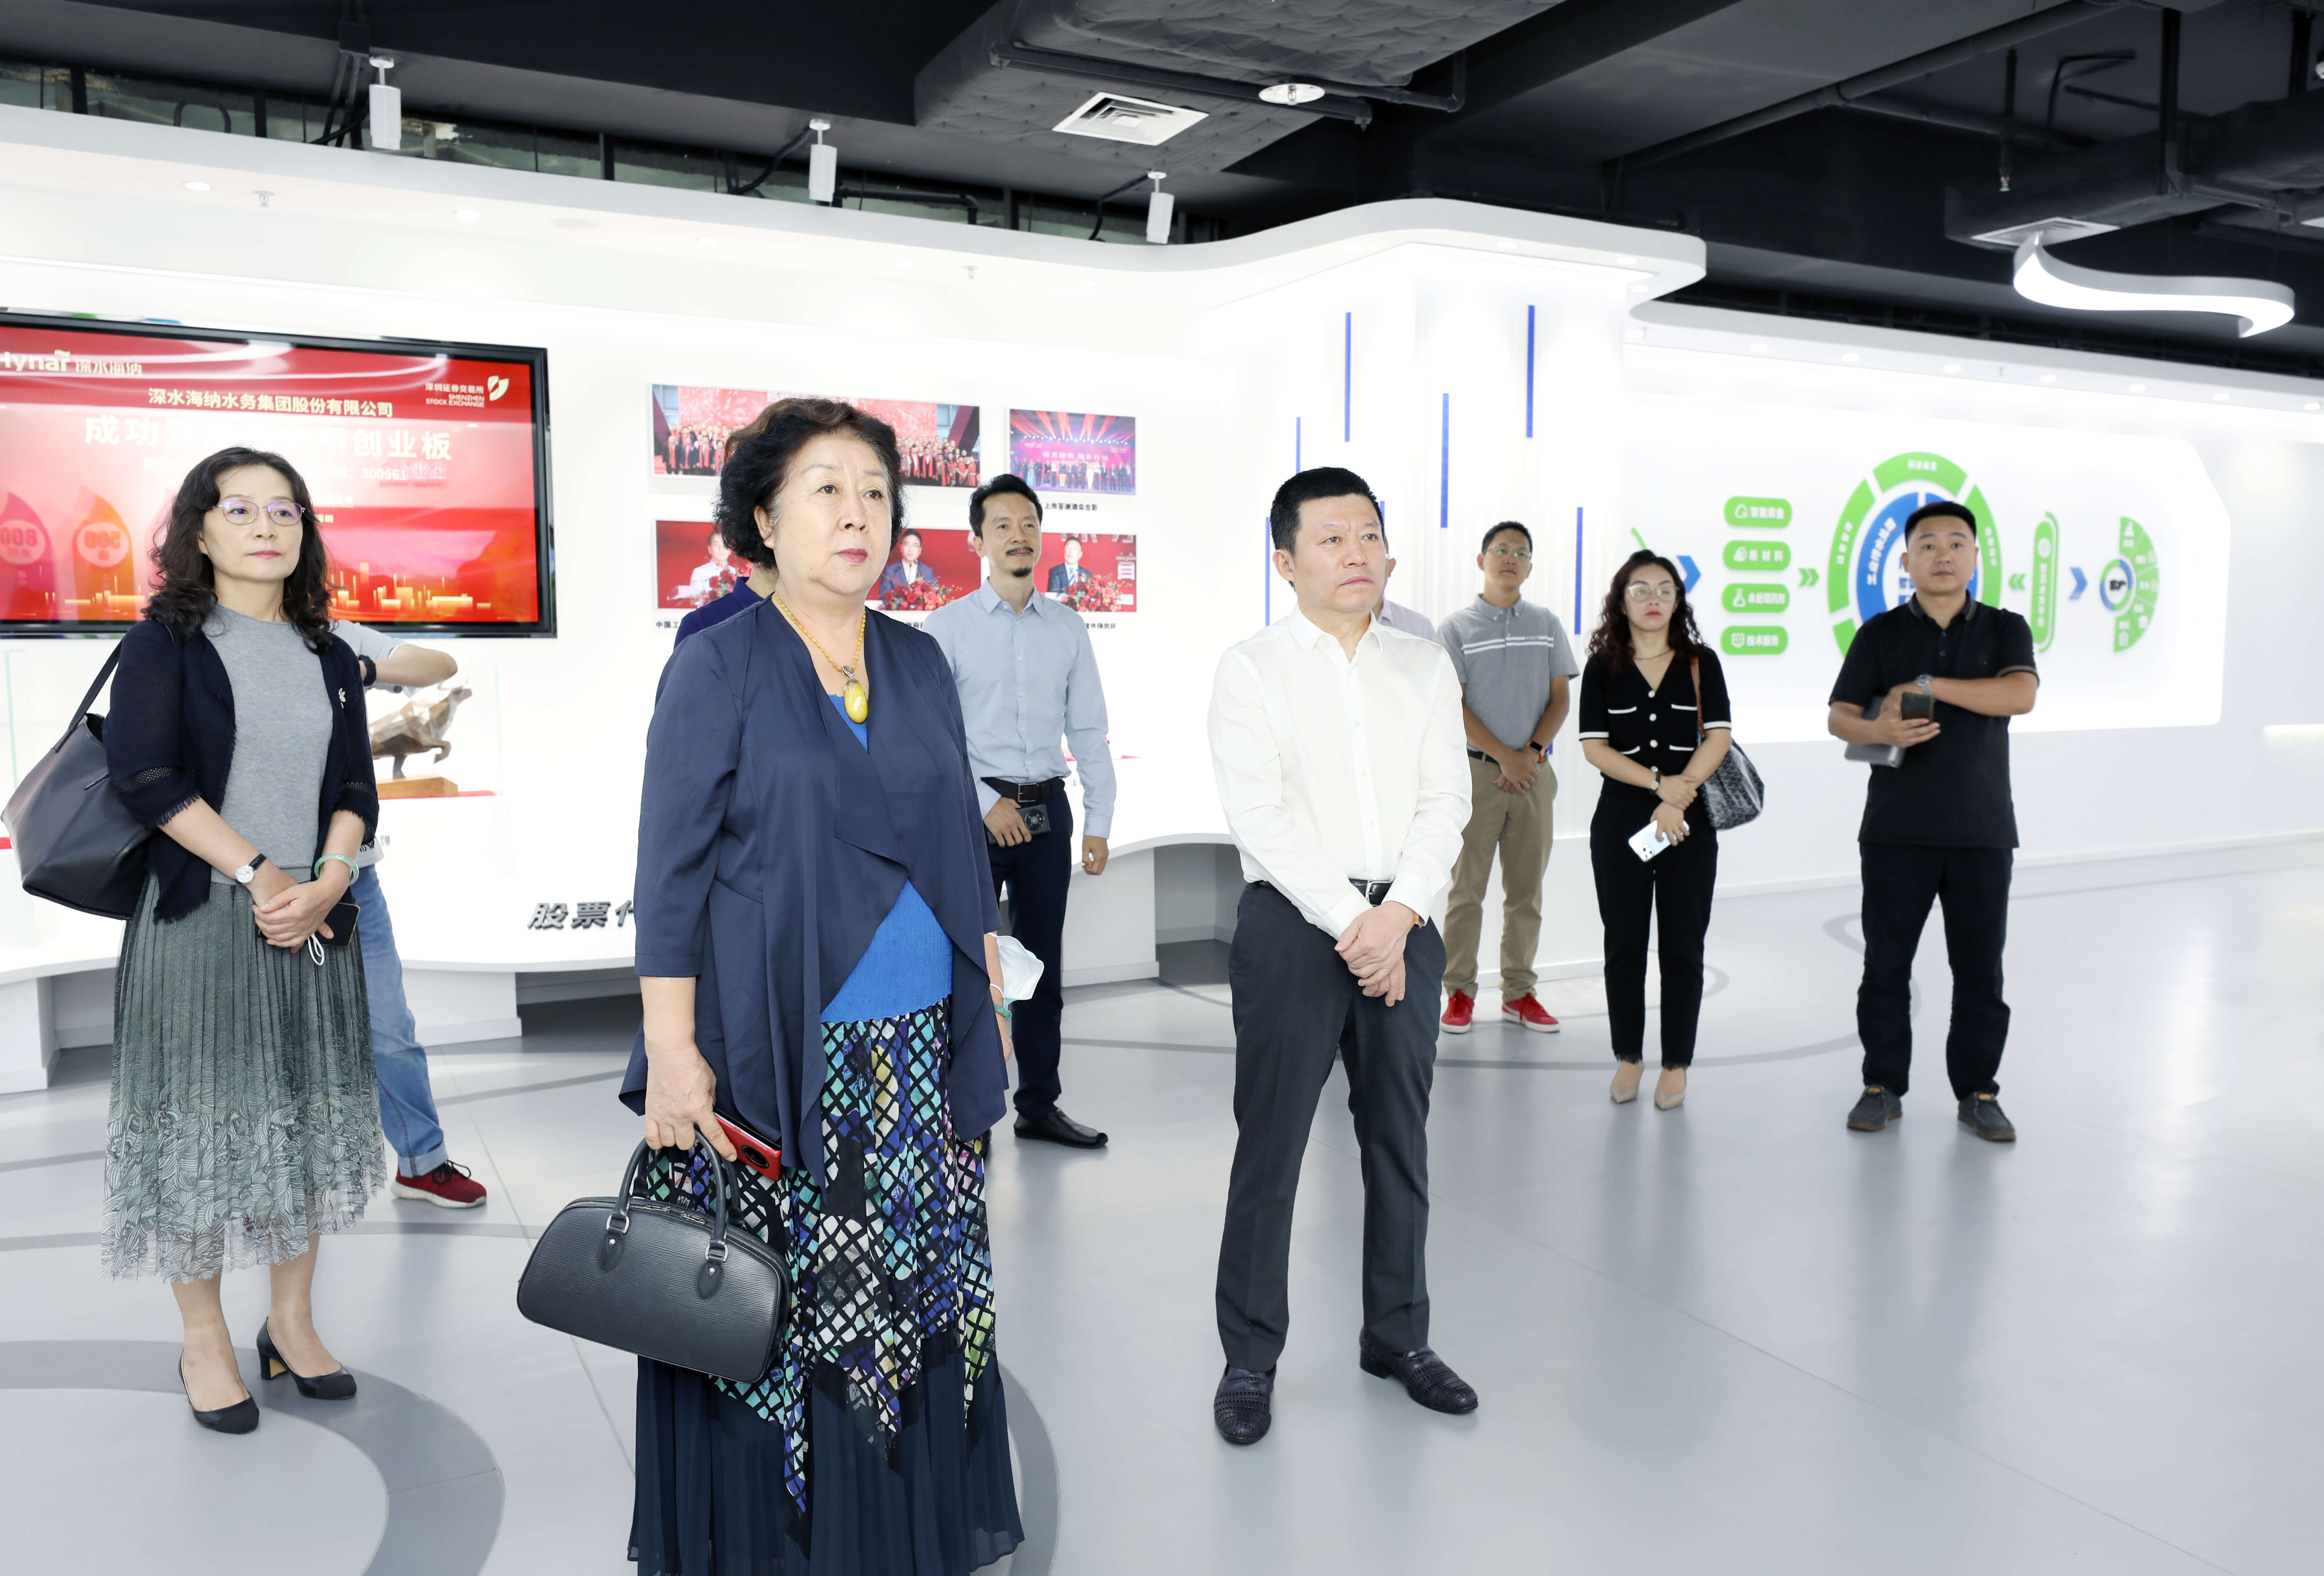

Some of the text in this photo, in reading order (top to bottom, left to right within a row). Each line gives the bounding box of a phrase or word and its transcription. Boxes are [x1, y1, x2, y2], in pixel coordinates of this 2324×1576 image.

[75, 358, 143, 376] 深水海纳
[425, 382, 484, 394] 深圳证券交易所
[148, 387, 393, 418] 深水海纳水务集团股份有限公司
[361, 468, 406, 480] 300961
